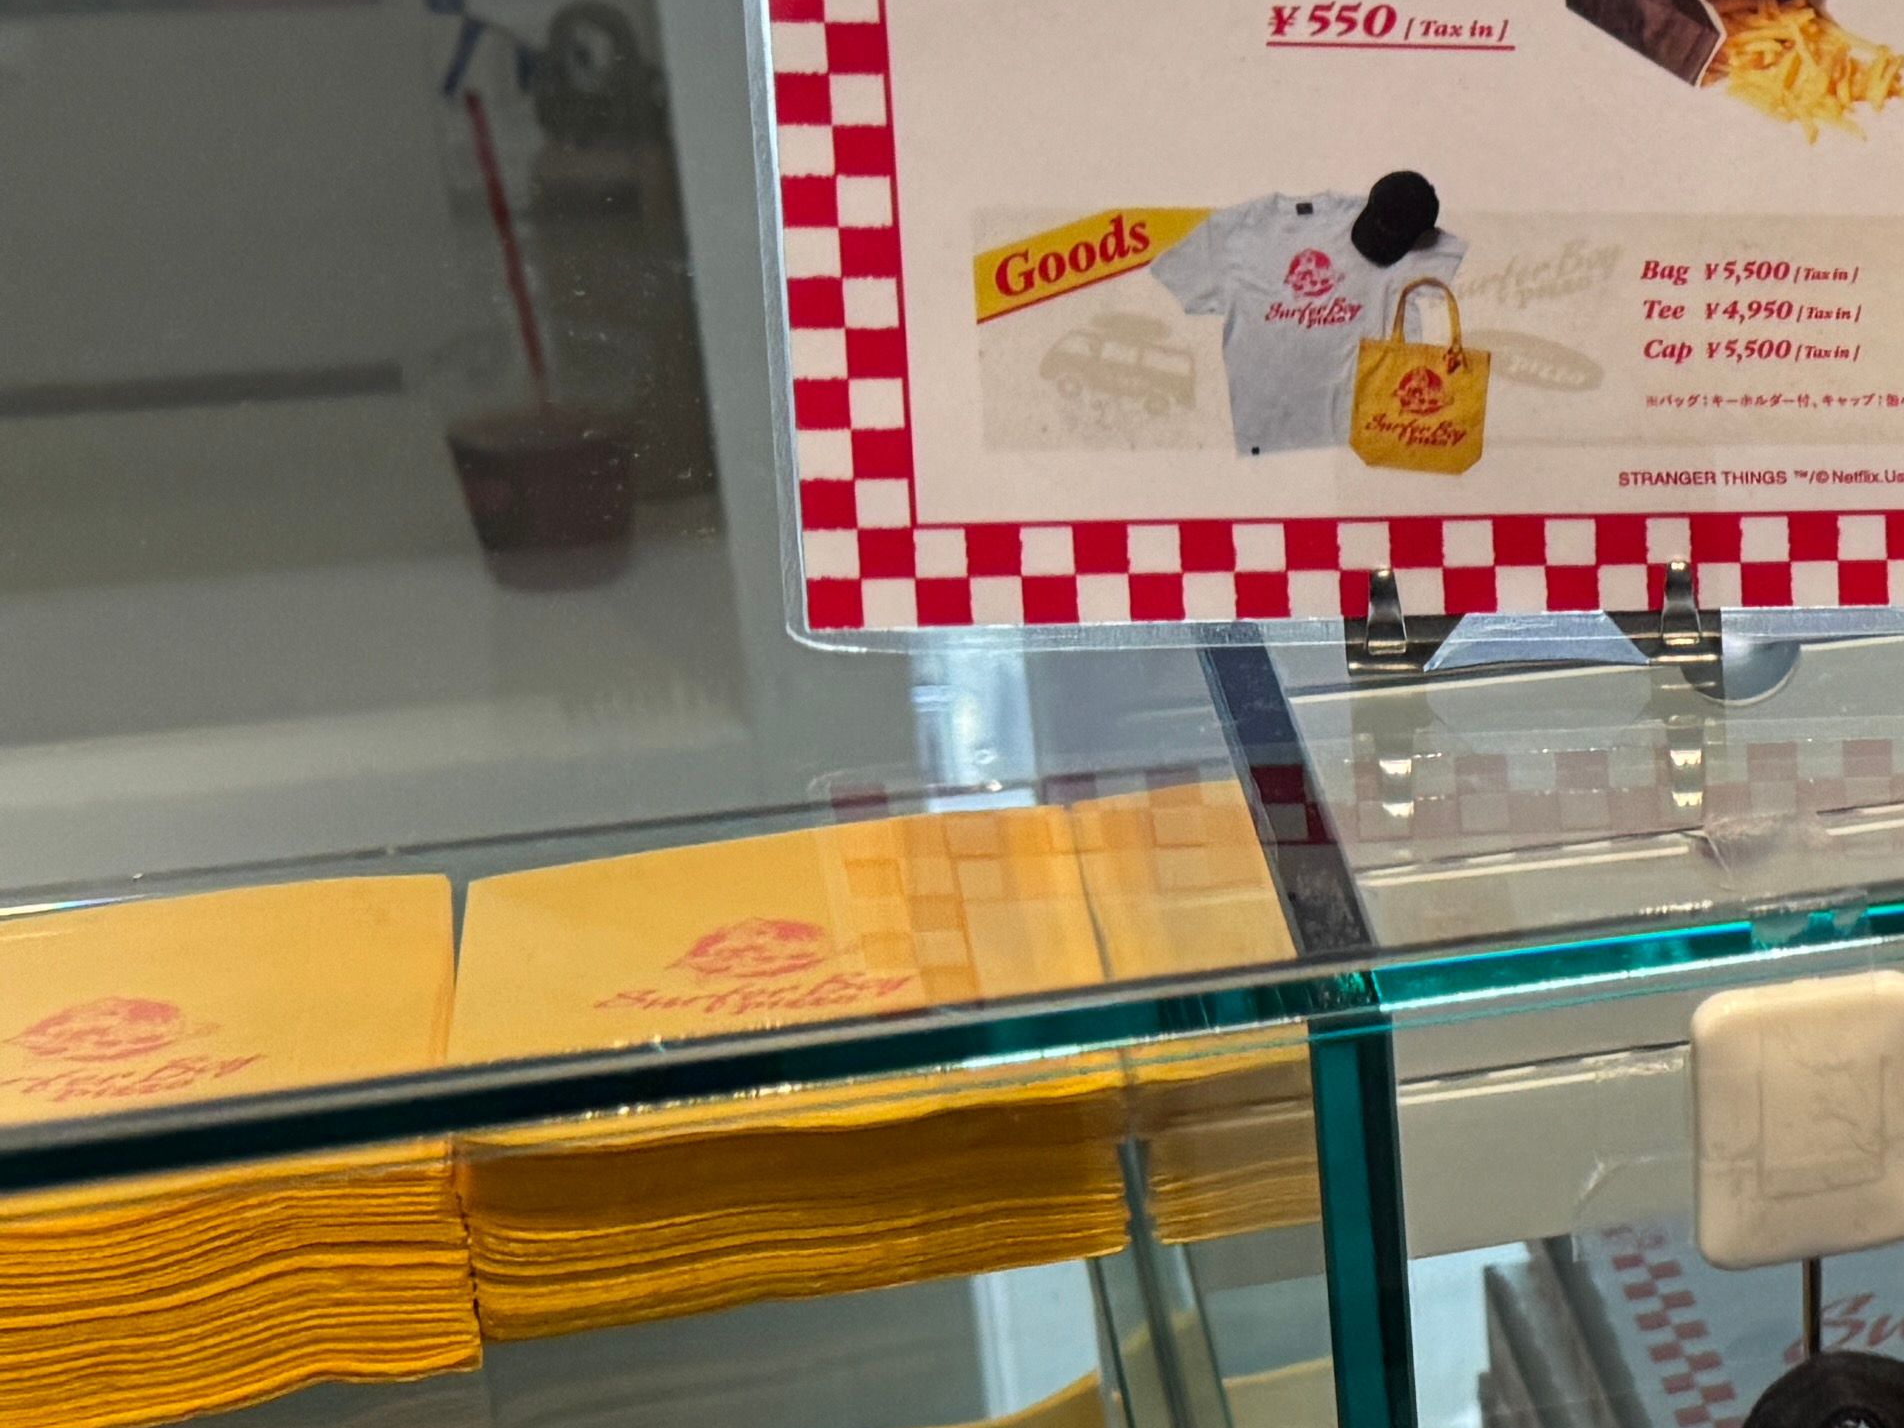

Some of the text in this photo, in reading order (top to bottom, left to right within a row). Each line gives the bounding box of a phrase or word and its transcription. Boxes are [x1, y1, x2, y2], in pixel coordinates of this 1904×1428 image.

[1267, 0, 1399, 39] ¥550
[994, 214, 1151, 297] Goods
[1640, 260, 1690, 285] Bag
[1643, 299, 1685, 321] Tee
[1644, 339, 1693, 364] Cap
[1618, 470, 1716, 487] STRANGER
[1723, 470, 1788, 486] THINGS
